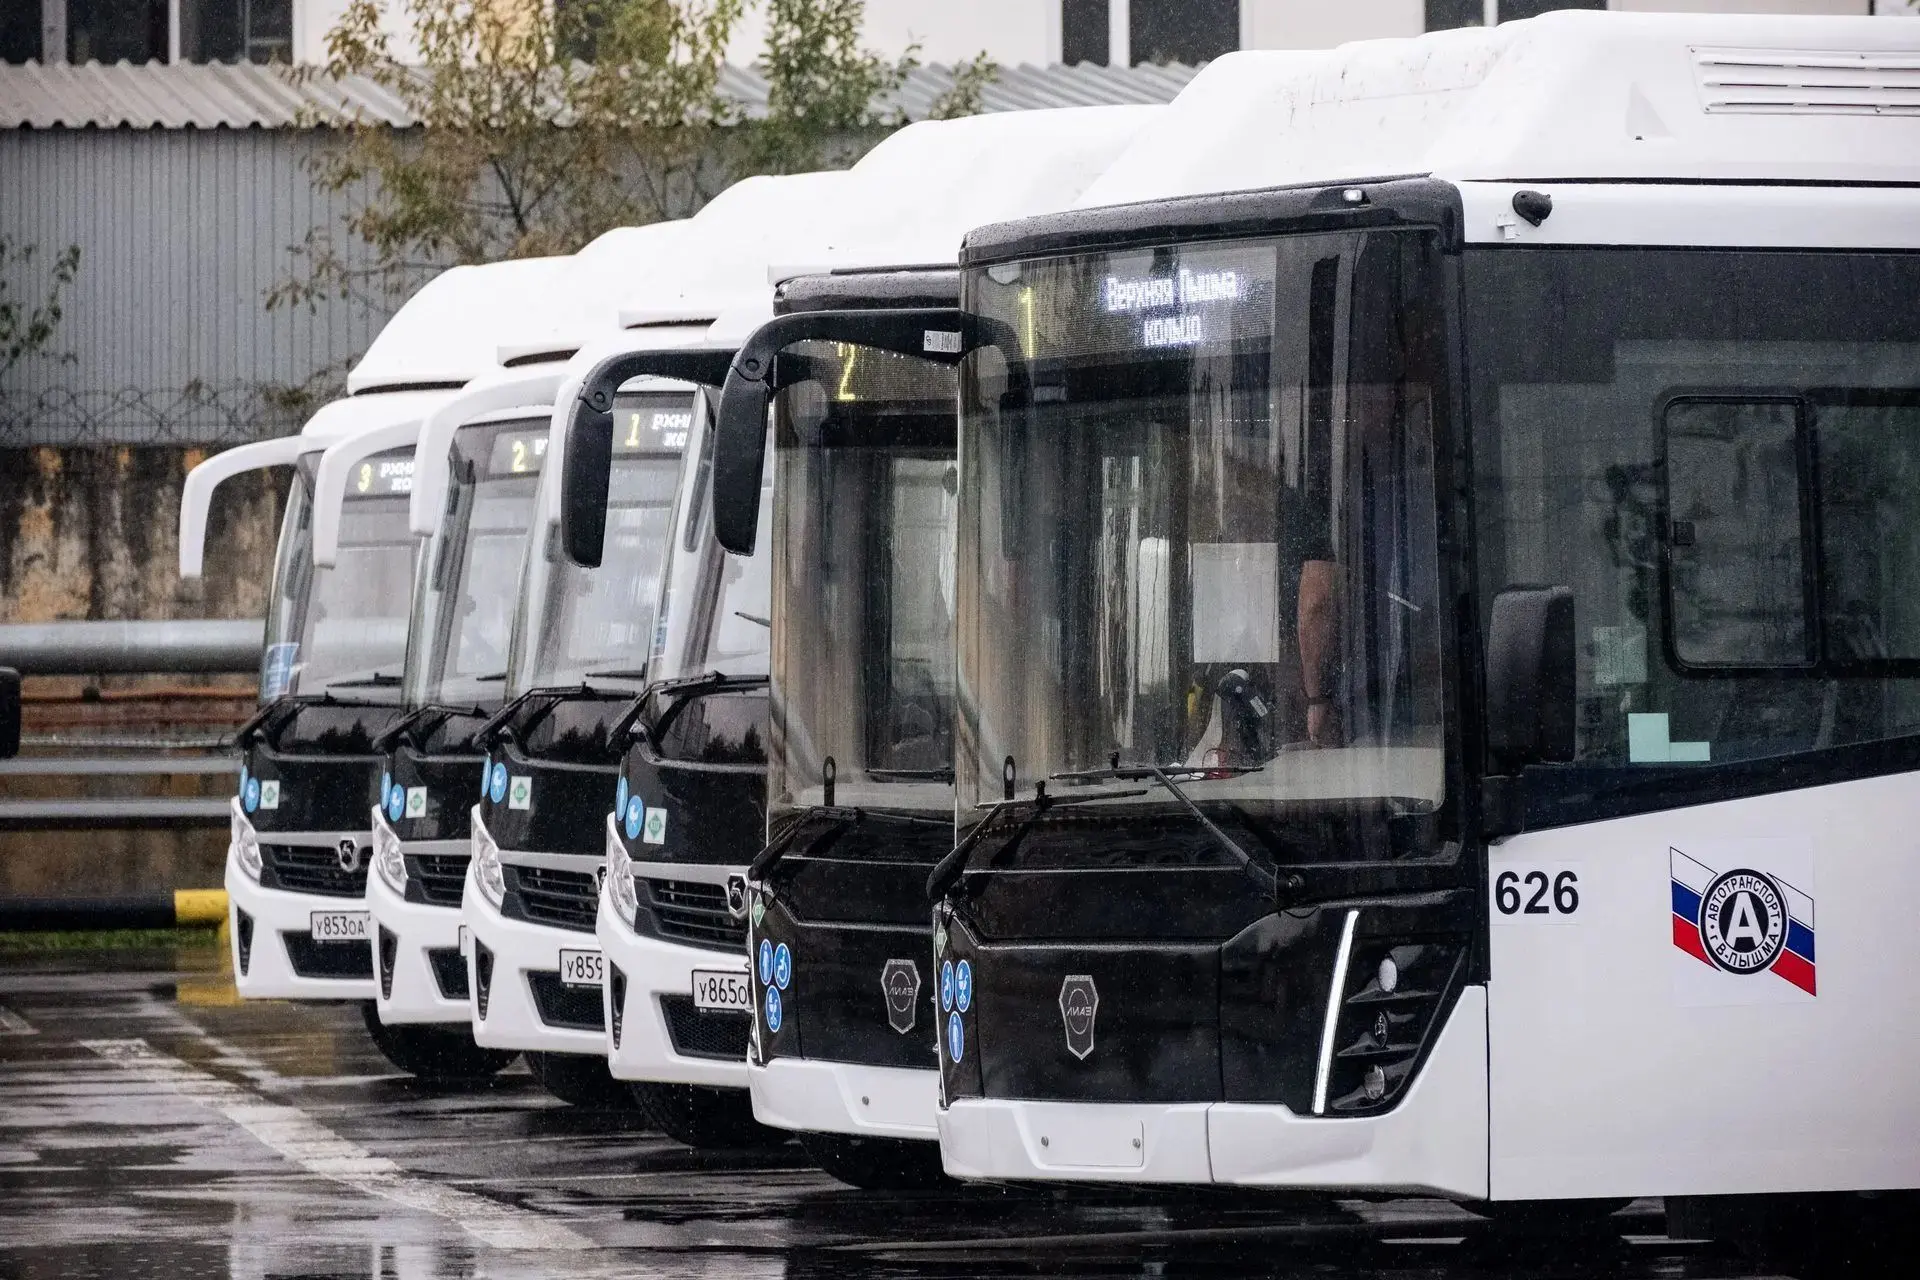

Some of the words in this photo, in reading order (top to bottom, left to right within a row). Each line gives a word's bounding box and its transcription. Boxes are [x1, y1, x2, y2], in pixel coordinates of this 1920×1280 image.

[1107, 278, 1173, 311] Верхняя
[1180, 269, 1237, 303] Пышма
[625, 414, 640, 447] 1
[513, 441, 525, 472] 2
[358, 463, 371, 492] 3
[1495, 870, 1579, 915] 626
[1707, 876, 1781, 922] АВТОТРАНСПОРТ
[1725, 892, 1764, 948] А
[1715, 933, 1780, 968] В-ПЫШМА
